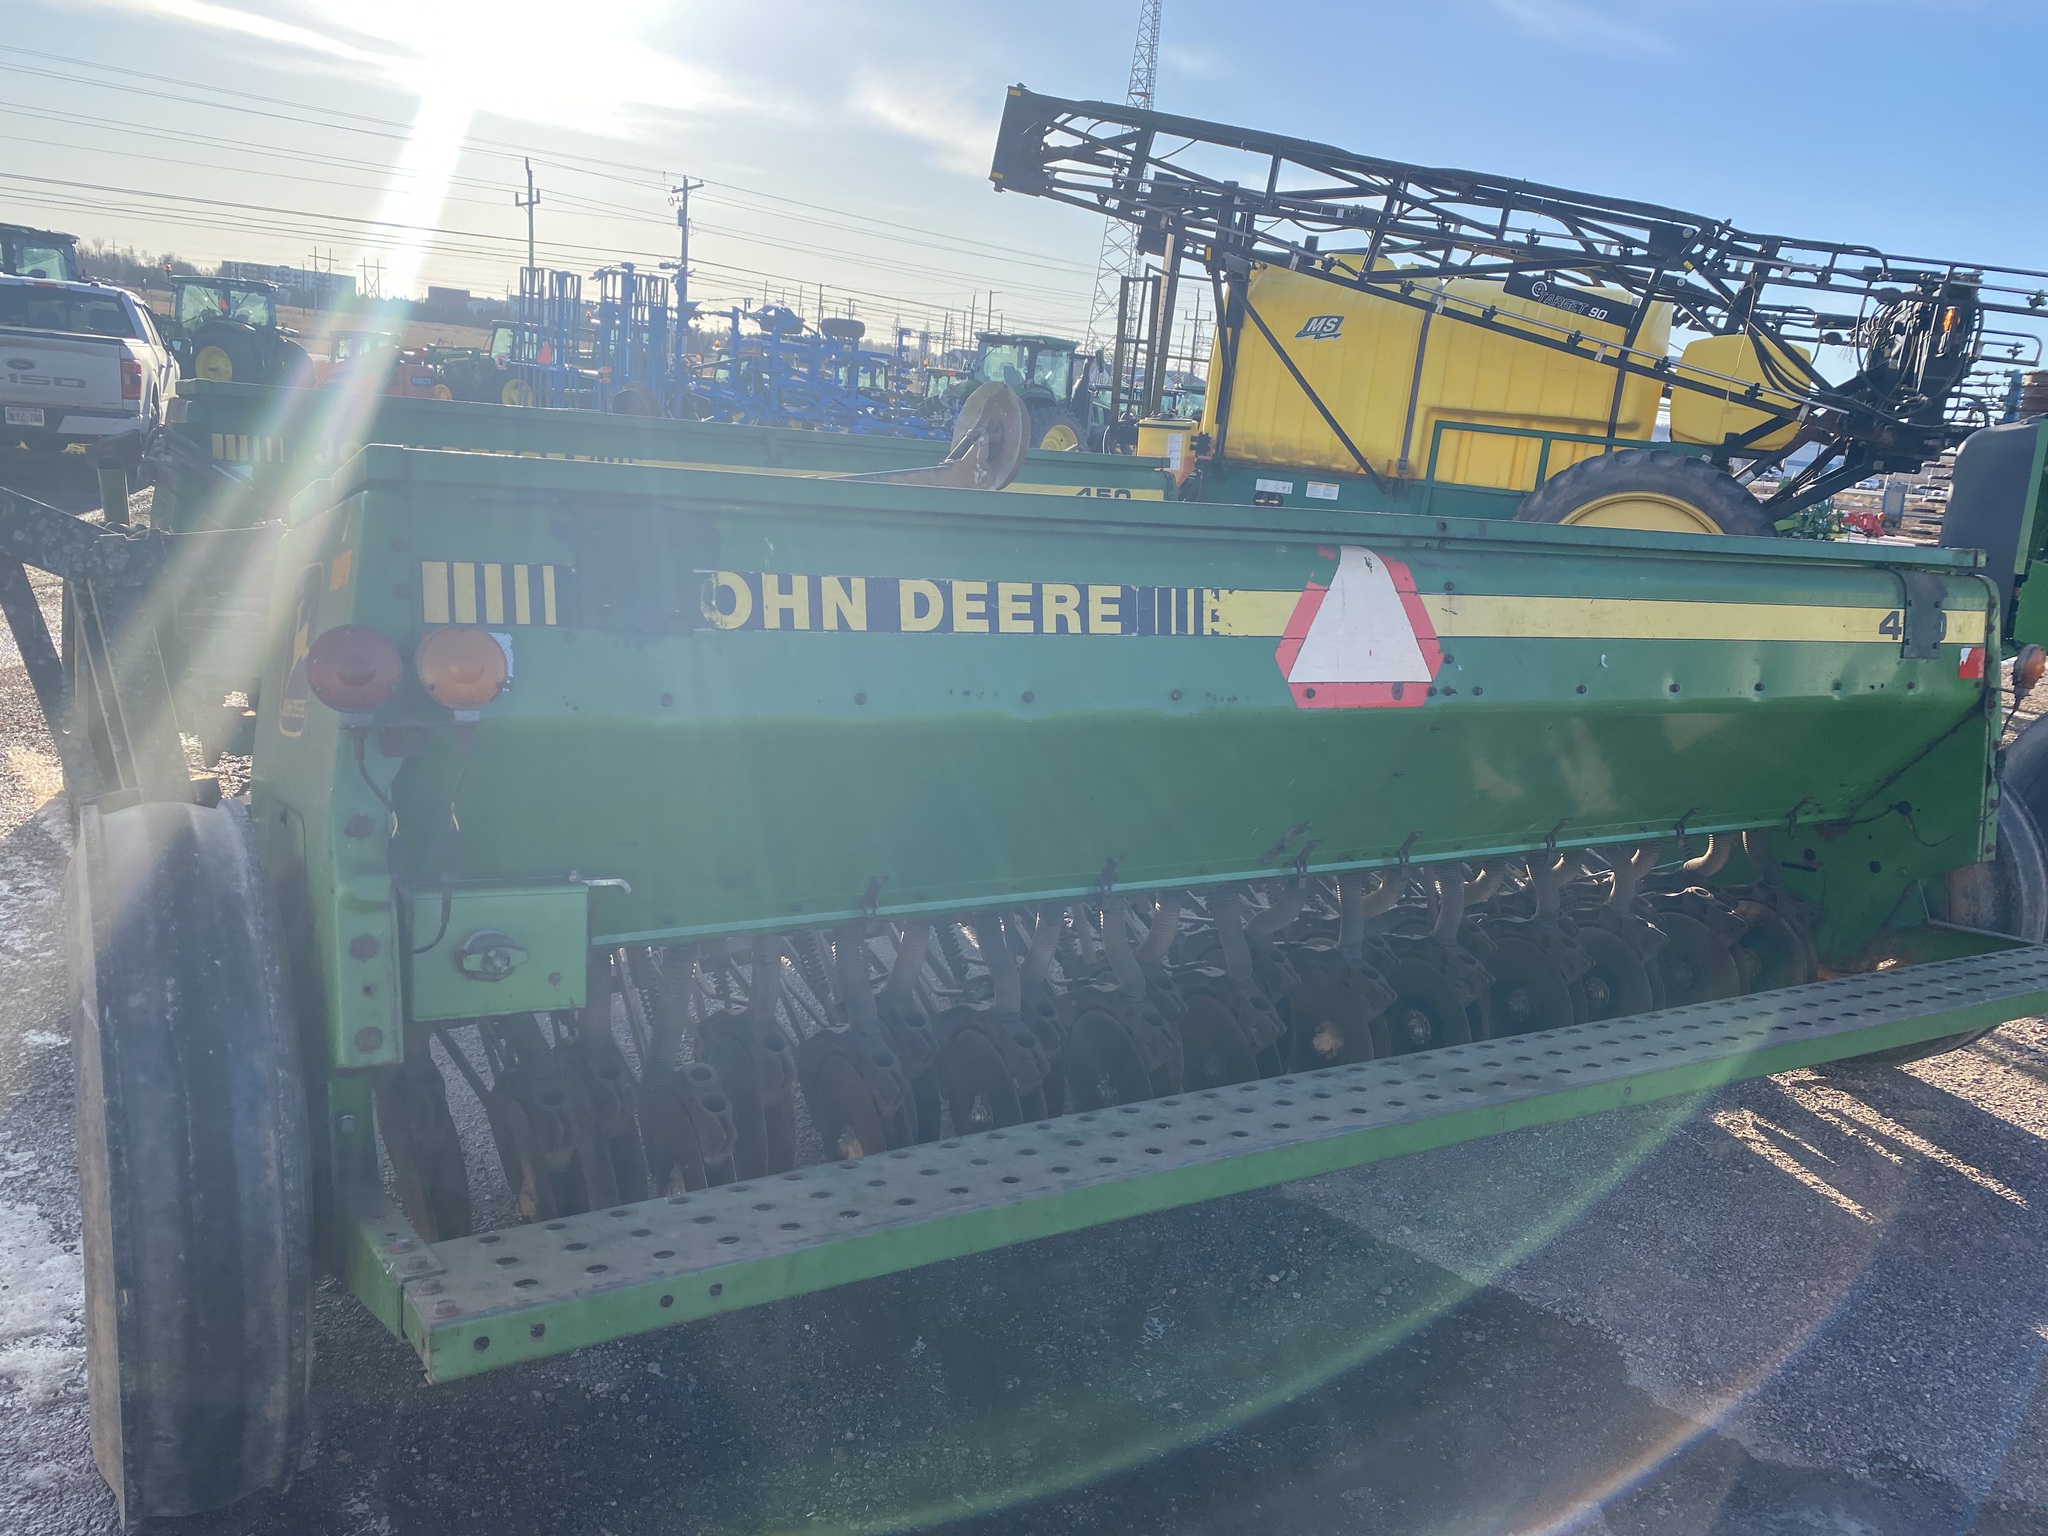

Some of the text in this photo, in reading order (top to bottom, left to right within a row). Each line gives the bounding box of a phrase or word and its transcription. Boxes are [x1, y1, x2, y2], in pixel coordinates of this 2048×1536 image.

[1537, 289, 1609, 321] TARGET 90
[1306, 317, 1339, 333] MS
[0, 373, 86, 389] -150
[701, 571, 1123, 634] OHN DEERE
